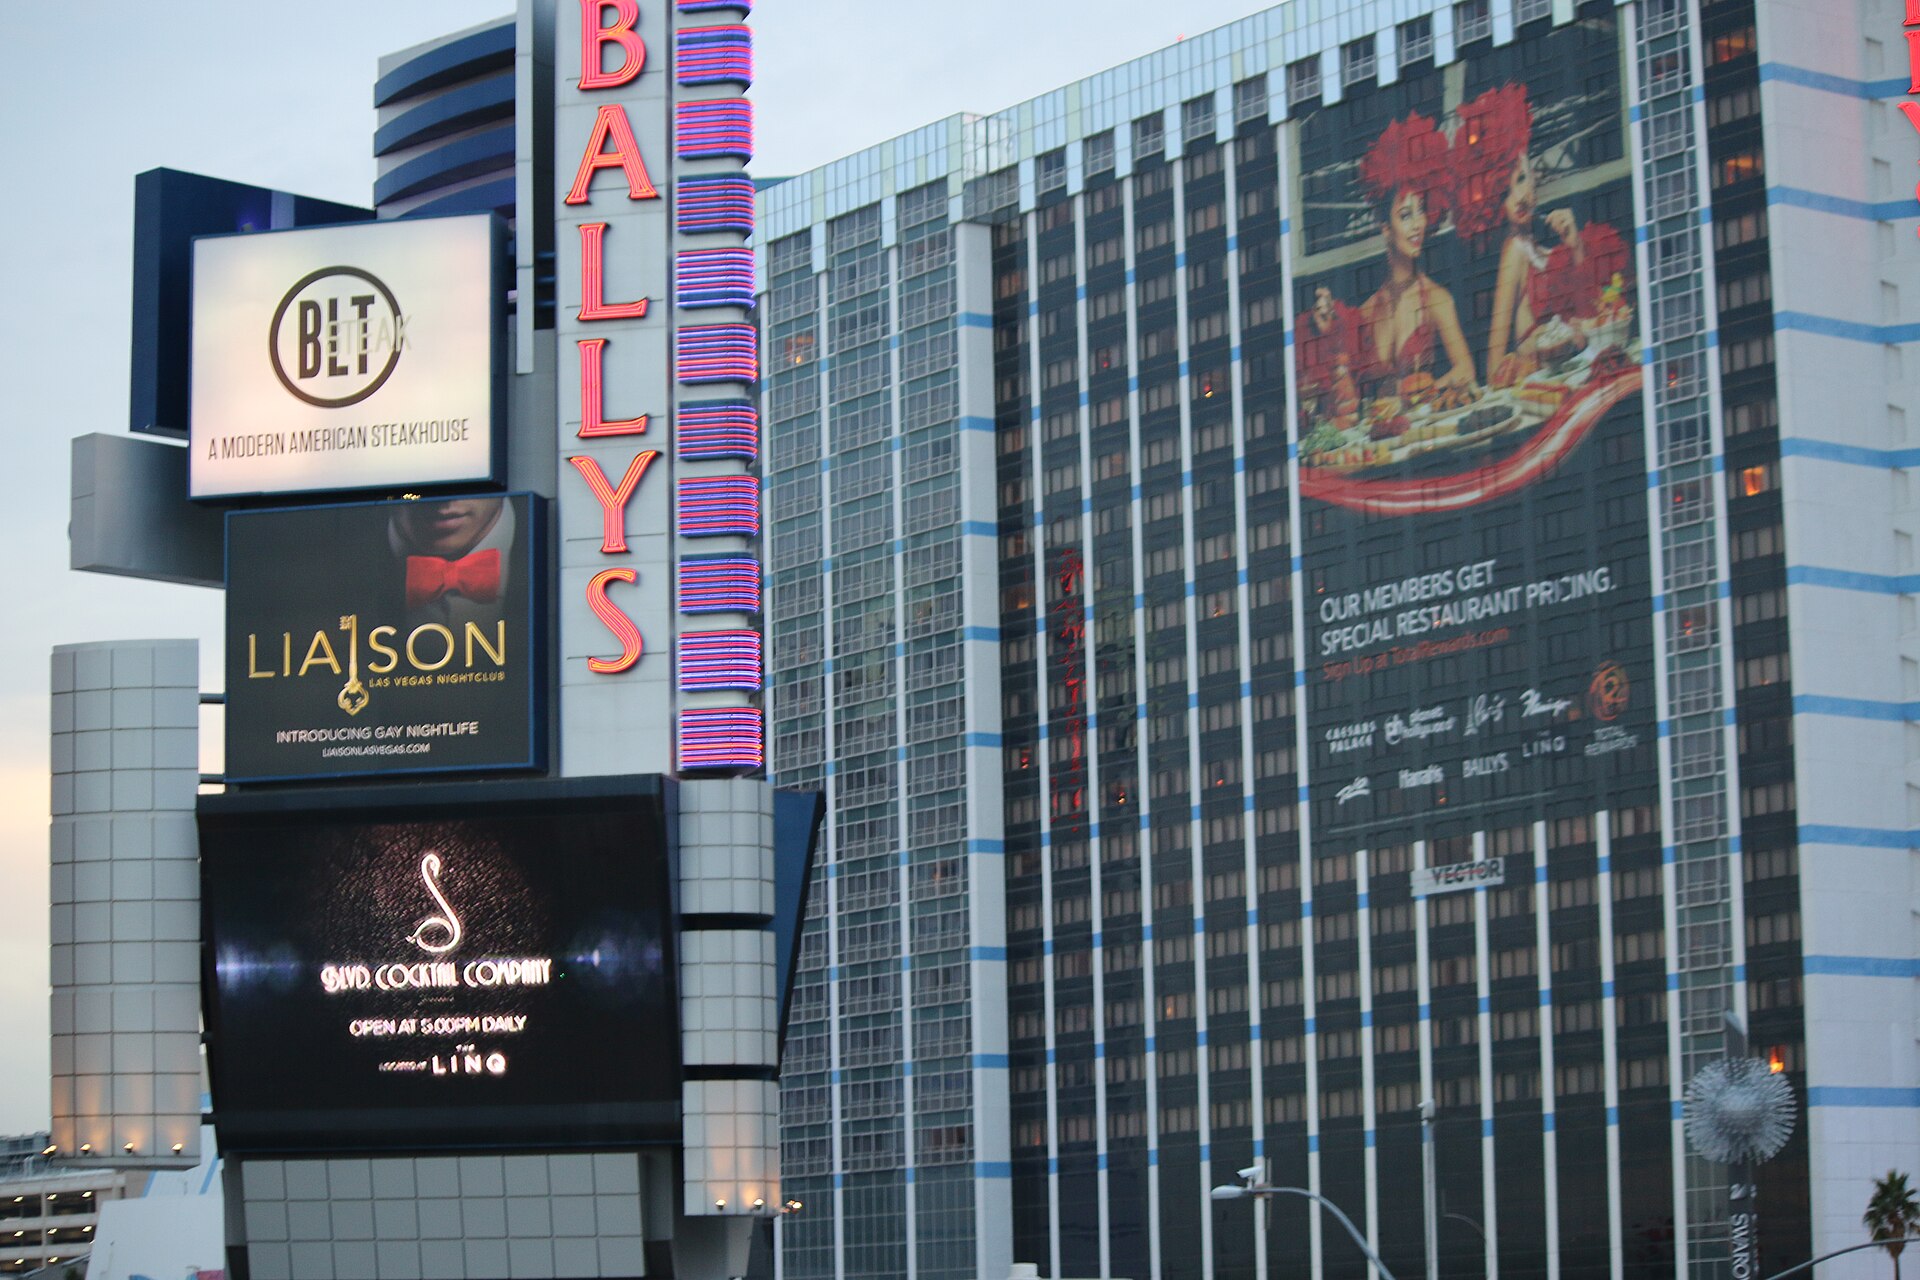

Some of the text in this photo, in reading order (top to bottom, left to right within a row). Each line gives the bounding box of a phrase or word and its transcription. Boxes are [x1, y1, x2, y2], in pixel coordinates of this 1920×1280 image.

[298, 294, 376, 380] BLT
[208, 418, 470, 460] A MODERN AMERICAN STEAKHOUSE
[1320, 559, 1497, 623] OUR MEMBERS GET
[1321, 616, 1394, 656] SPECIAL
[1396, 585, 1523, 637] RESTAURANT
[247, 614, 506, 716] LIAISON
[369, 671, 505, 688] LAS VEGAS NIGHTCLUB
[276, 721, 480, 744] INTRODUCING GAY NIGHTLIFE
[322, 742, 431, 758] LIAISONLASVEGAS.COM
[1431, 859, 1501, 885] VECTOR
[462, 958, 552, 988] COMPANY
[349, 1019, 396, 1037] OPEN
[397, 1018, 418, 1036] AT
[481, 1015, 528, 1033] DAILY
[1731, 1213, 1751, 1280] SWARO
